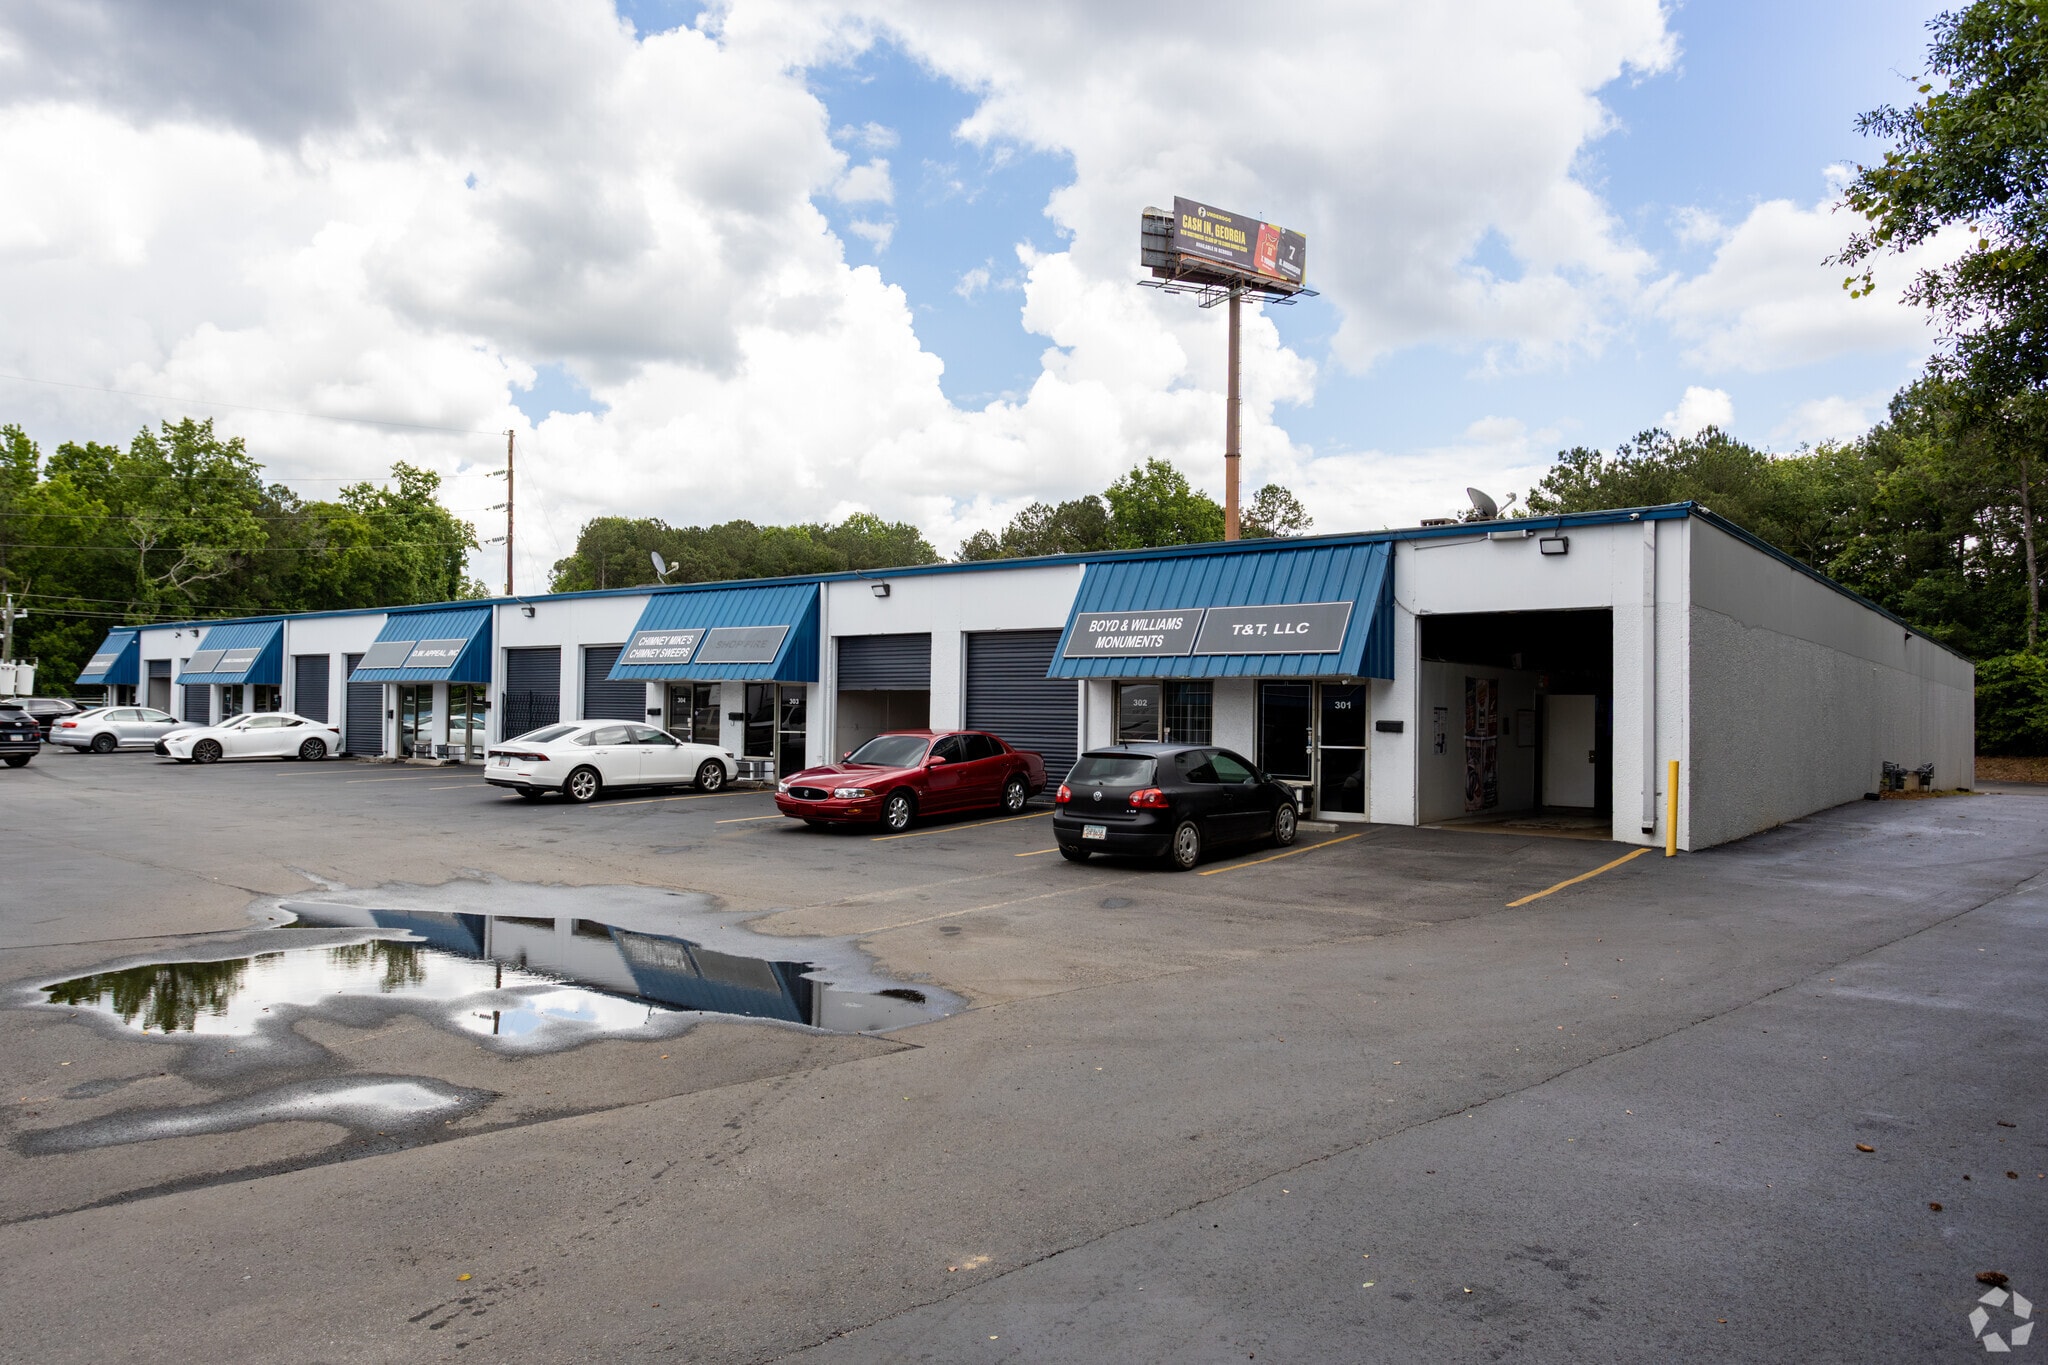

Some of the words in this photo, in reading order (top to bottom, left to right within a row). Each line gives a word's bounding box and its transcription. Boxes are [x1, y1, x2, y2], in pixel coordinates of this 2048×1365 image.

[1182, 214, 1202, 232] CASH
[1203, 220, 1214, 237] IN,
[1215, 223, 1246, 245] GEORGIA
[1289, 245, 1296, 260] 7
[1088, 619, 1119, 632] BOYD
[1120, 619, 1129, 632] &
[1130, 617, 1184, 632] WILLIAMS
[1232, 623, 1268, 637] T&T,
[1273, 622, 1310, 635] LLC
[638, 635, 670, 646] CHIMNEY
[668, 634, 695, 645] MIKE'S
[1094, 634, 1165, 649] MONUMENTS
[629, 648, 660, 658] CHIMNEY
[659, 647, 691, 658] SWEEPS
[1133, 699, 1148, 707] 302
[1334, 701, 1352, 709] 301
